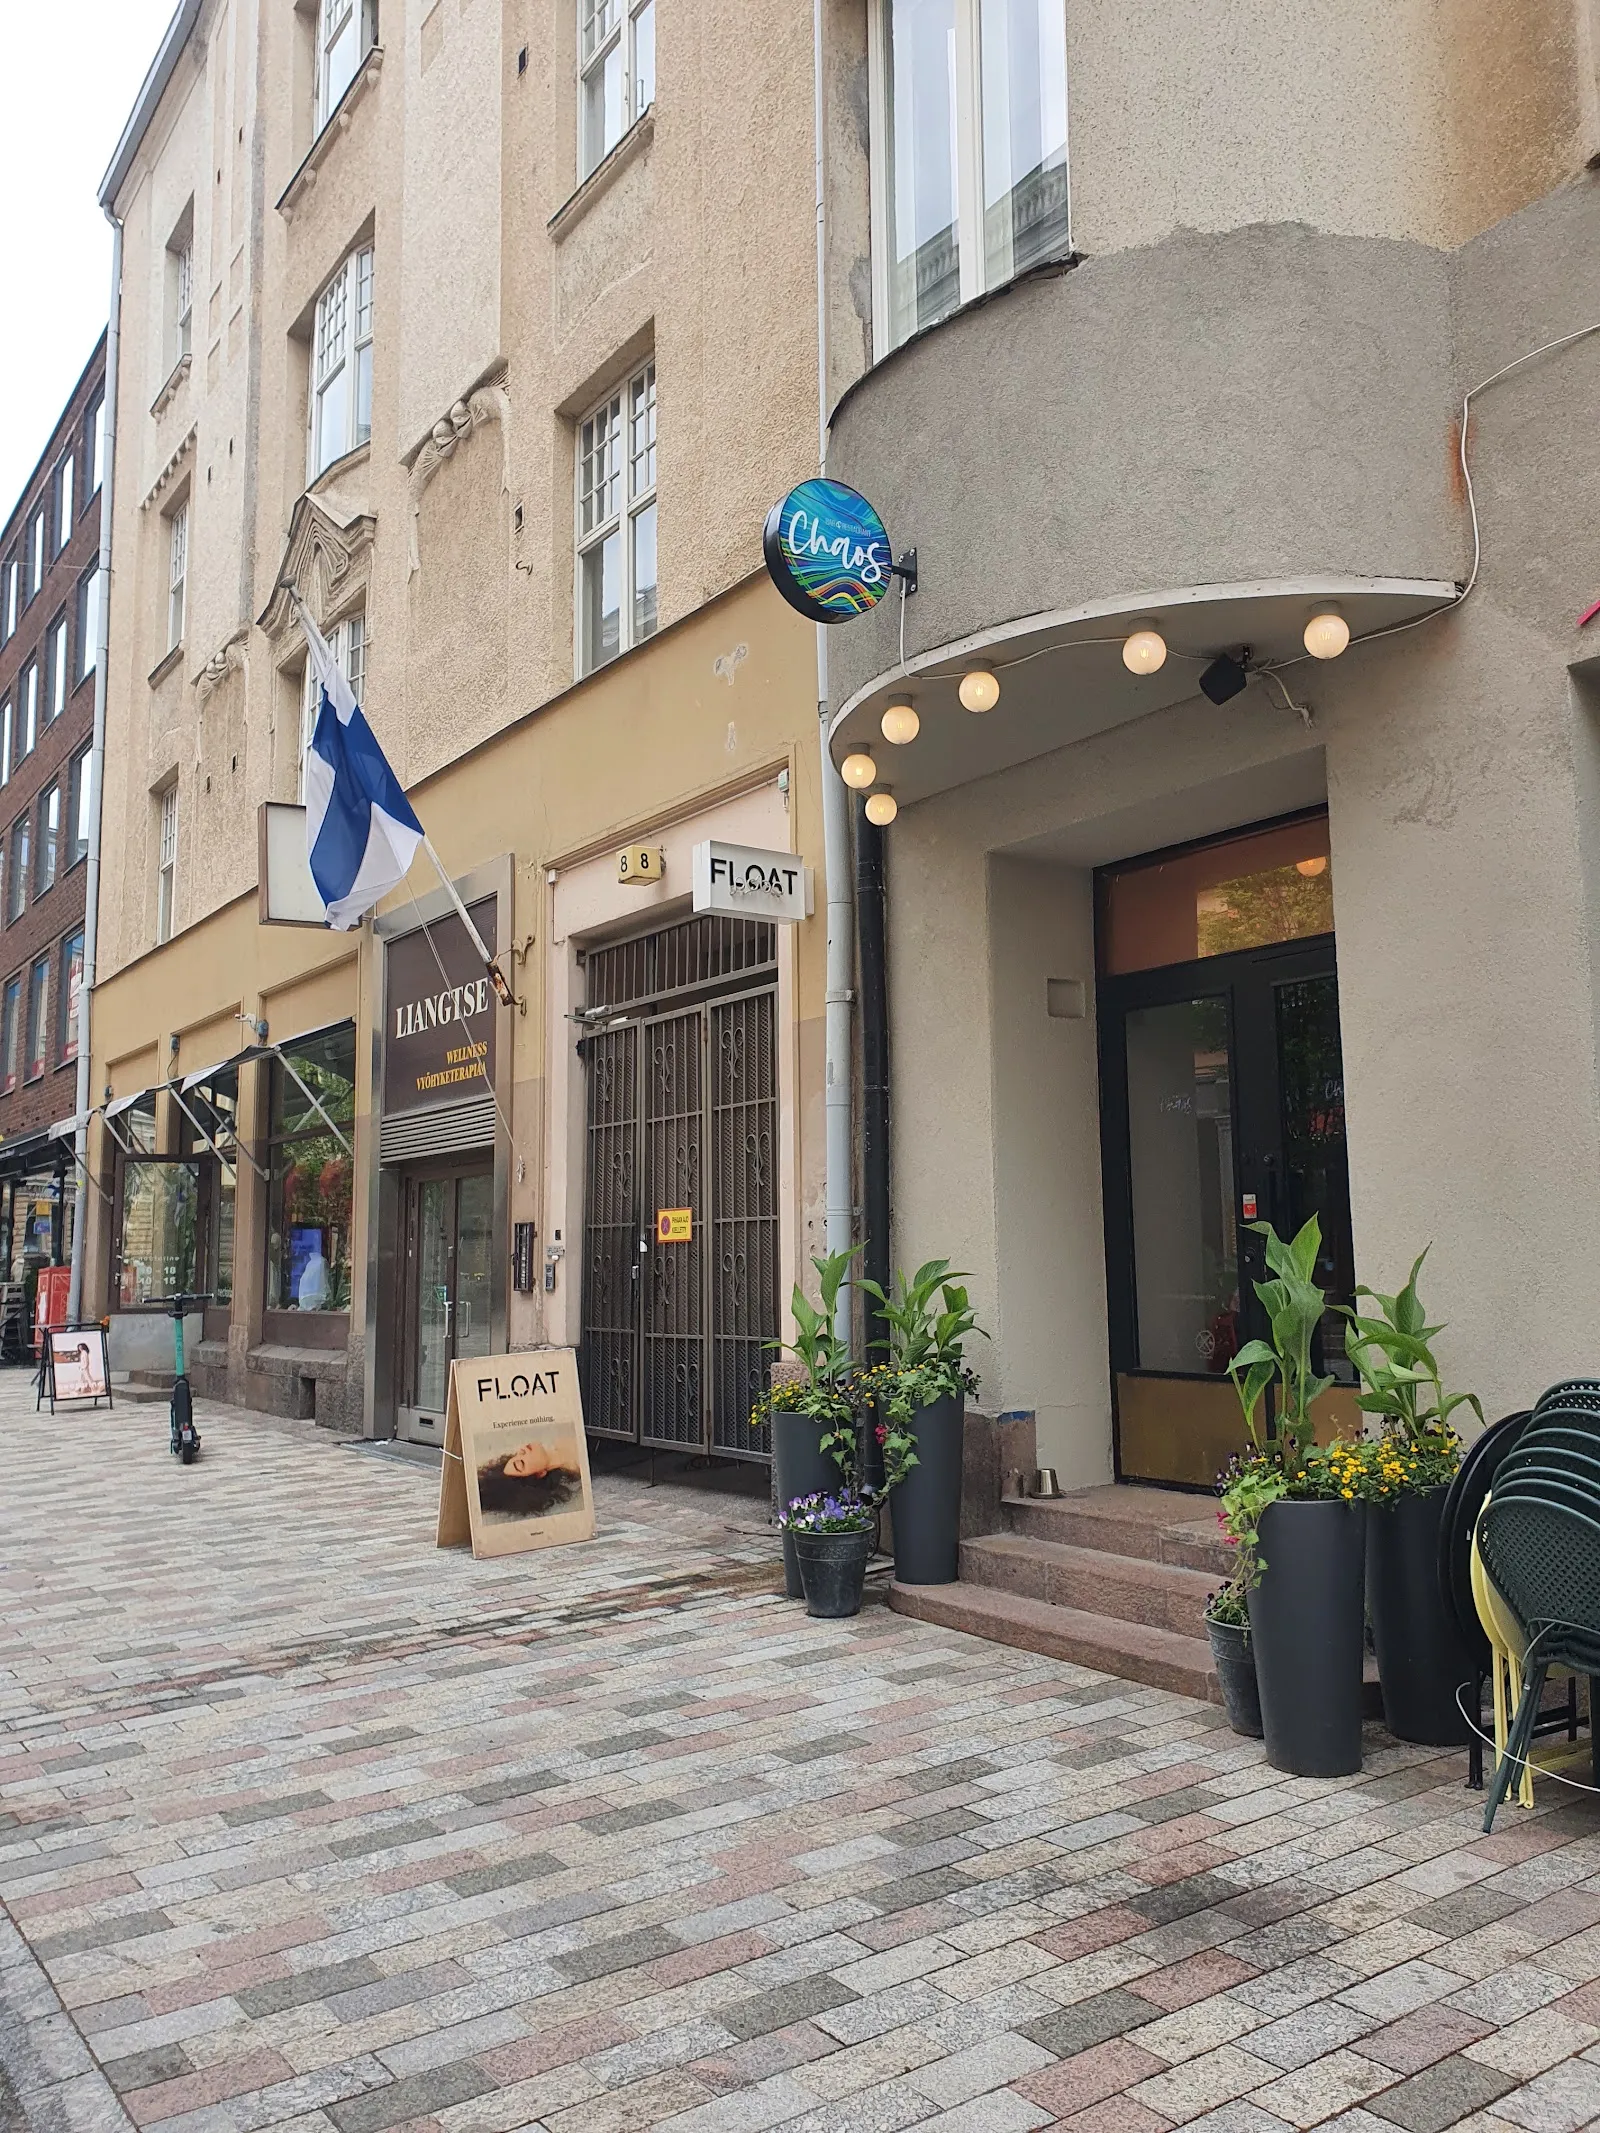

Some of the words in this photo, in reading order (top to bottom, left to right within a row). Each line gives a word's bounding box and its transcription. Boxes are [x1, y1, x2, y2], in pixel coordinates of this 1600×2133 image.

[842, 523, 872, 537] RESTAURANT
[789, 510, 888, 583] Chaos
[620, 855, 628, 873] 8
[640, 852, 649, 869] 8
[711, 857, 798, 895] FLOAT
[396, 977, 489, 1039] LIANGTSE
[446, 1041, 488, 1065] WELLNESS
[477, 1371, 560, 1402] FLOAT
[492, 1419, 528, 1429] Experience
